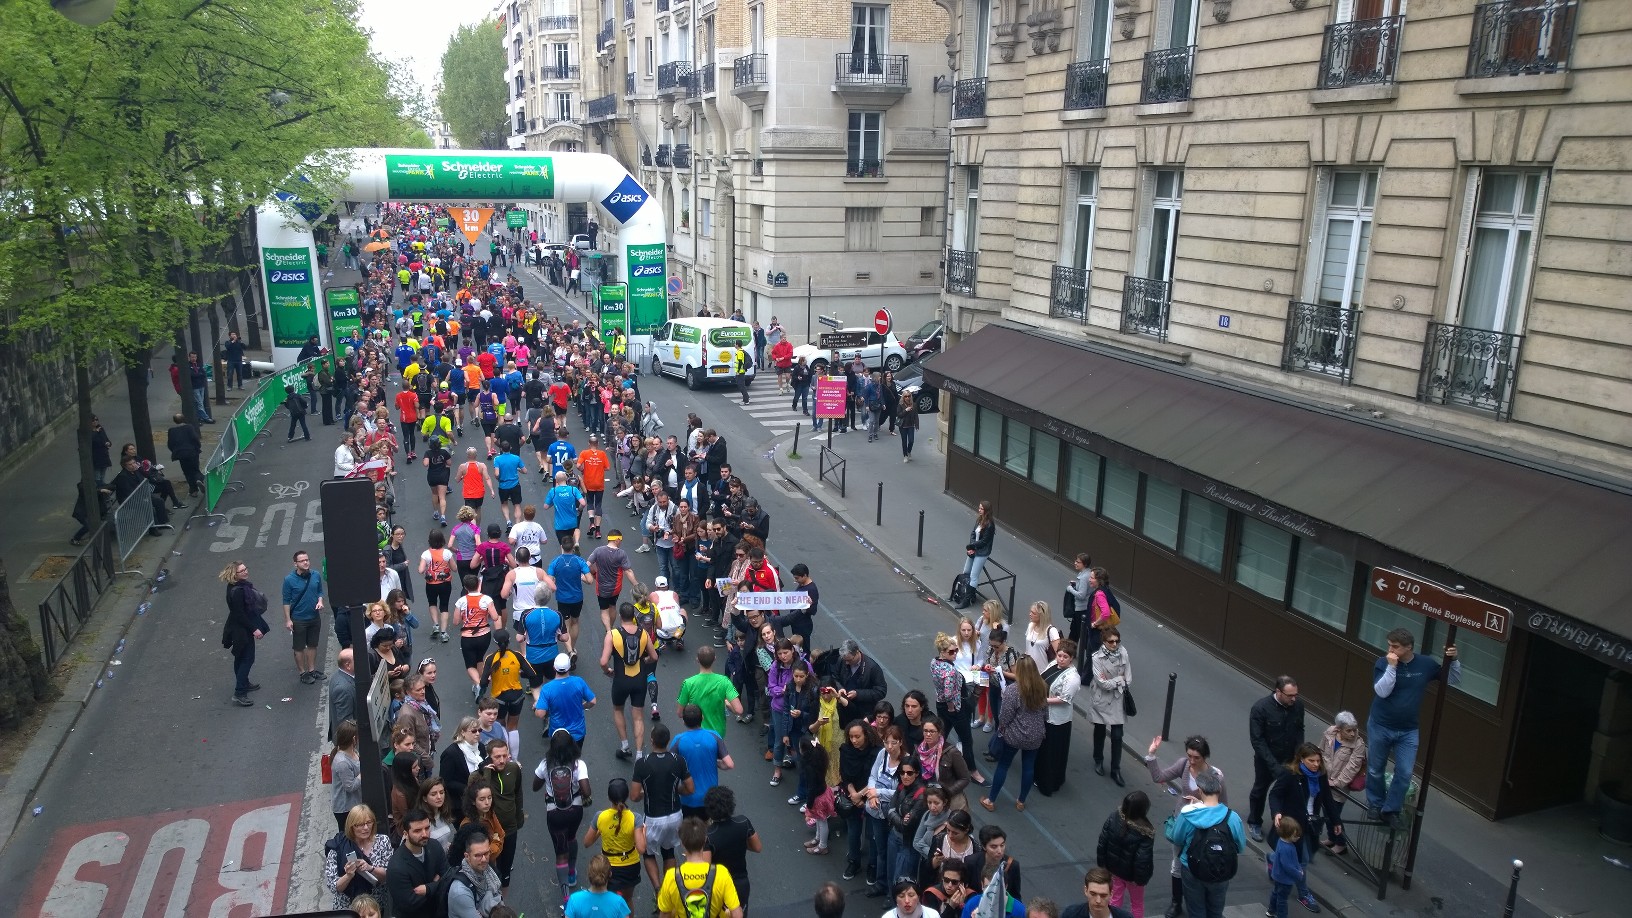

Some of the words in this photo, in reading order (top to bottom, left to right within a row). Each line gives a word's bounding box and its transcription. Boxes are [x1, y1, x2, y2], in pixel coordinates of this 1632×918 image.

[441, 161, 503, 172] Schneider
[620, 194, 642, 203] asics
[462, 210, 480, 222] 30
[464, 224, 479, 232] km
[265, 253, 307, 261] Schneider
[630, 249, 664, 259] Schneider
[643, 266, 662, 275] asics
[281, 272, 305, 281] asics
[614, 302, 624, 311] 30
[346, 307, 357, 316] 30
[720, 330, 747, 338] Europcar
[281, 365, 309, 388] Schnei
[554, 451, 569, 467] 14
[1203, 482, 1257, 512] Restaurant
[1398, 580, 1421, 595] CIO
[753, 596, 771, 605] END
[773, 596, 783, 605] IS
[1396, 593, 1406, 603] 16
[1422, 602, 1442, 616] René
[1444, 610, 1482, 629] Boylesve
